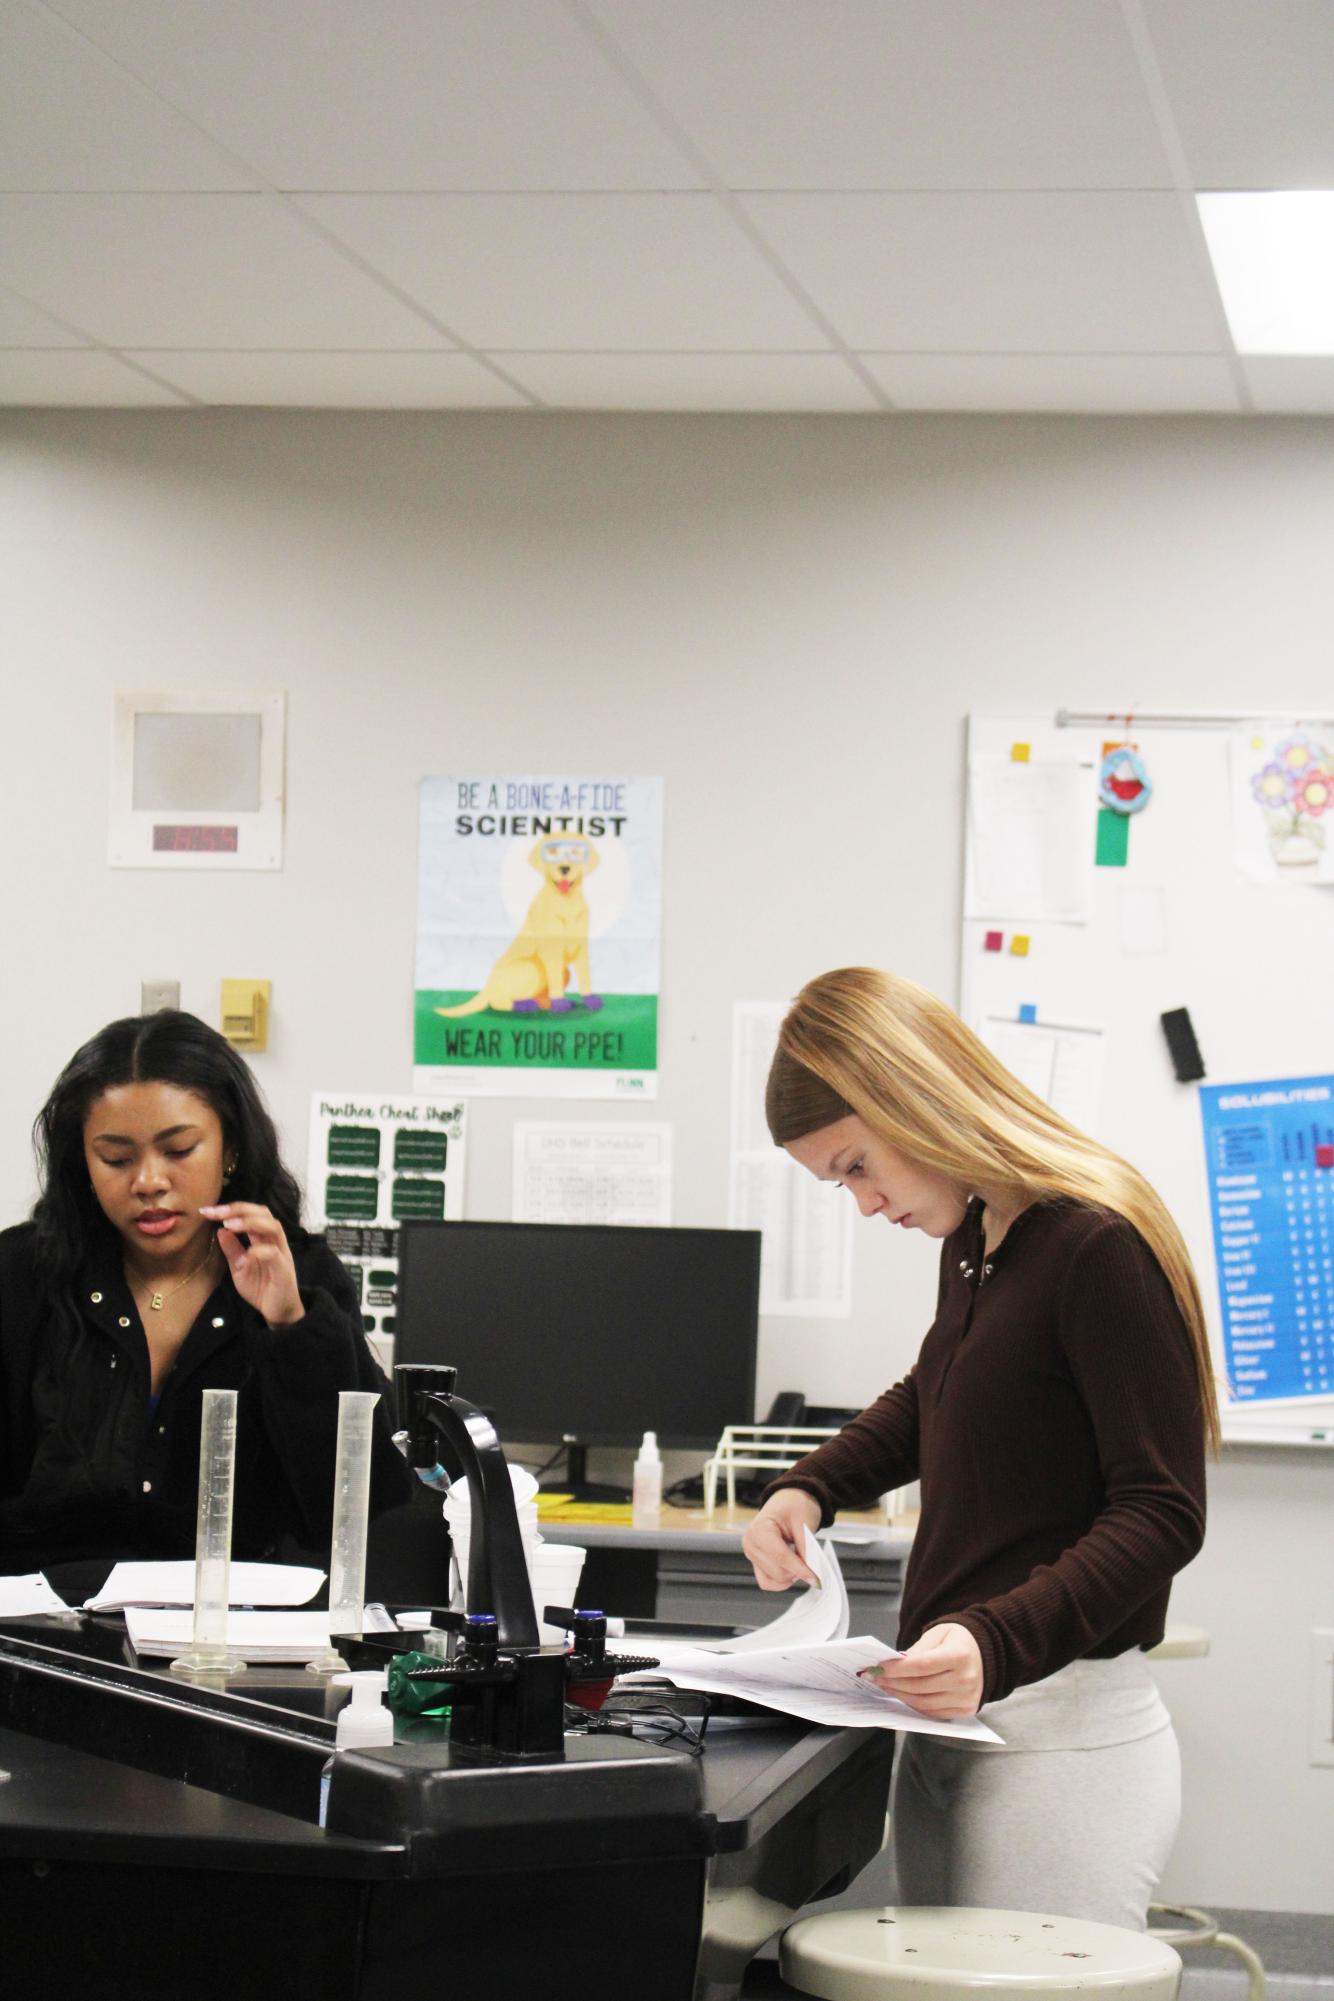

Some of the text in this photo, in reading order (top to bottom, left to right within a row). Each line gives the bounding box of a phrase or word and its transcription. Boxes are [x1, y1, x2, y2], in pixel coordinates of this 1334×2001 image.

[458, 782, 626, 811] BE A BONE-A-FIDE
[456, 814, 627, 837] SCIENTIST
[445, 1029, 624, 1062] WEAR YOUR PPE!
